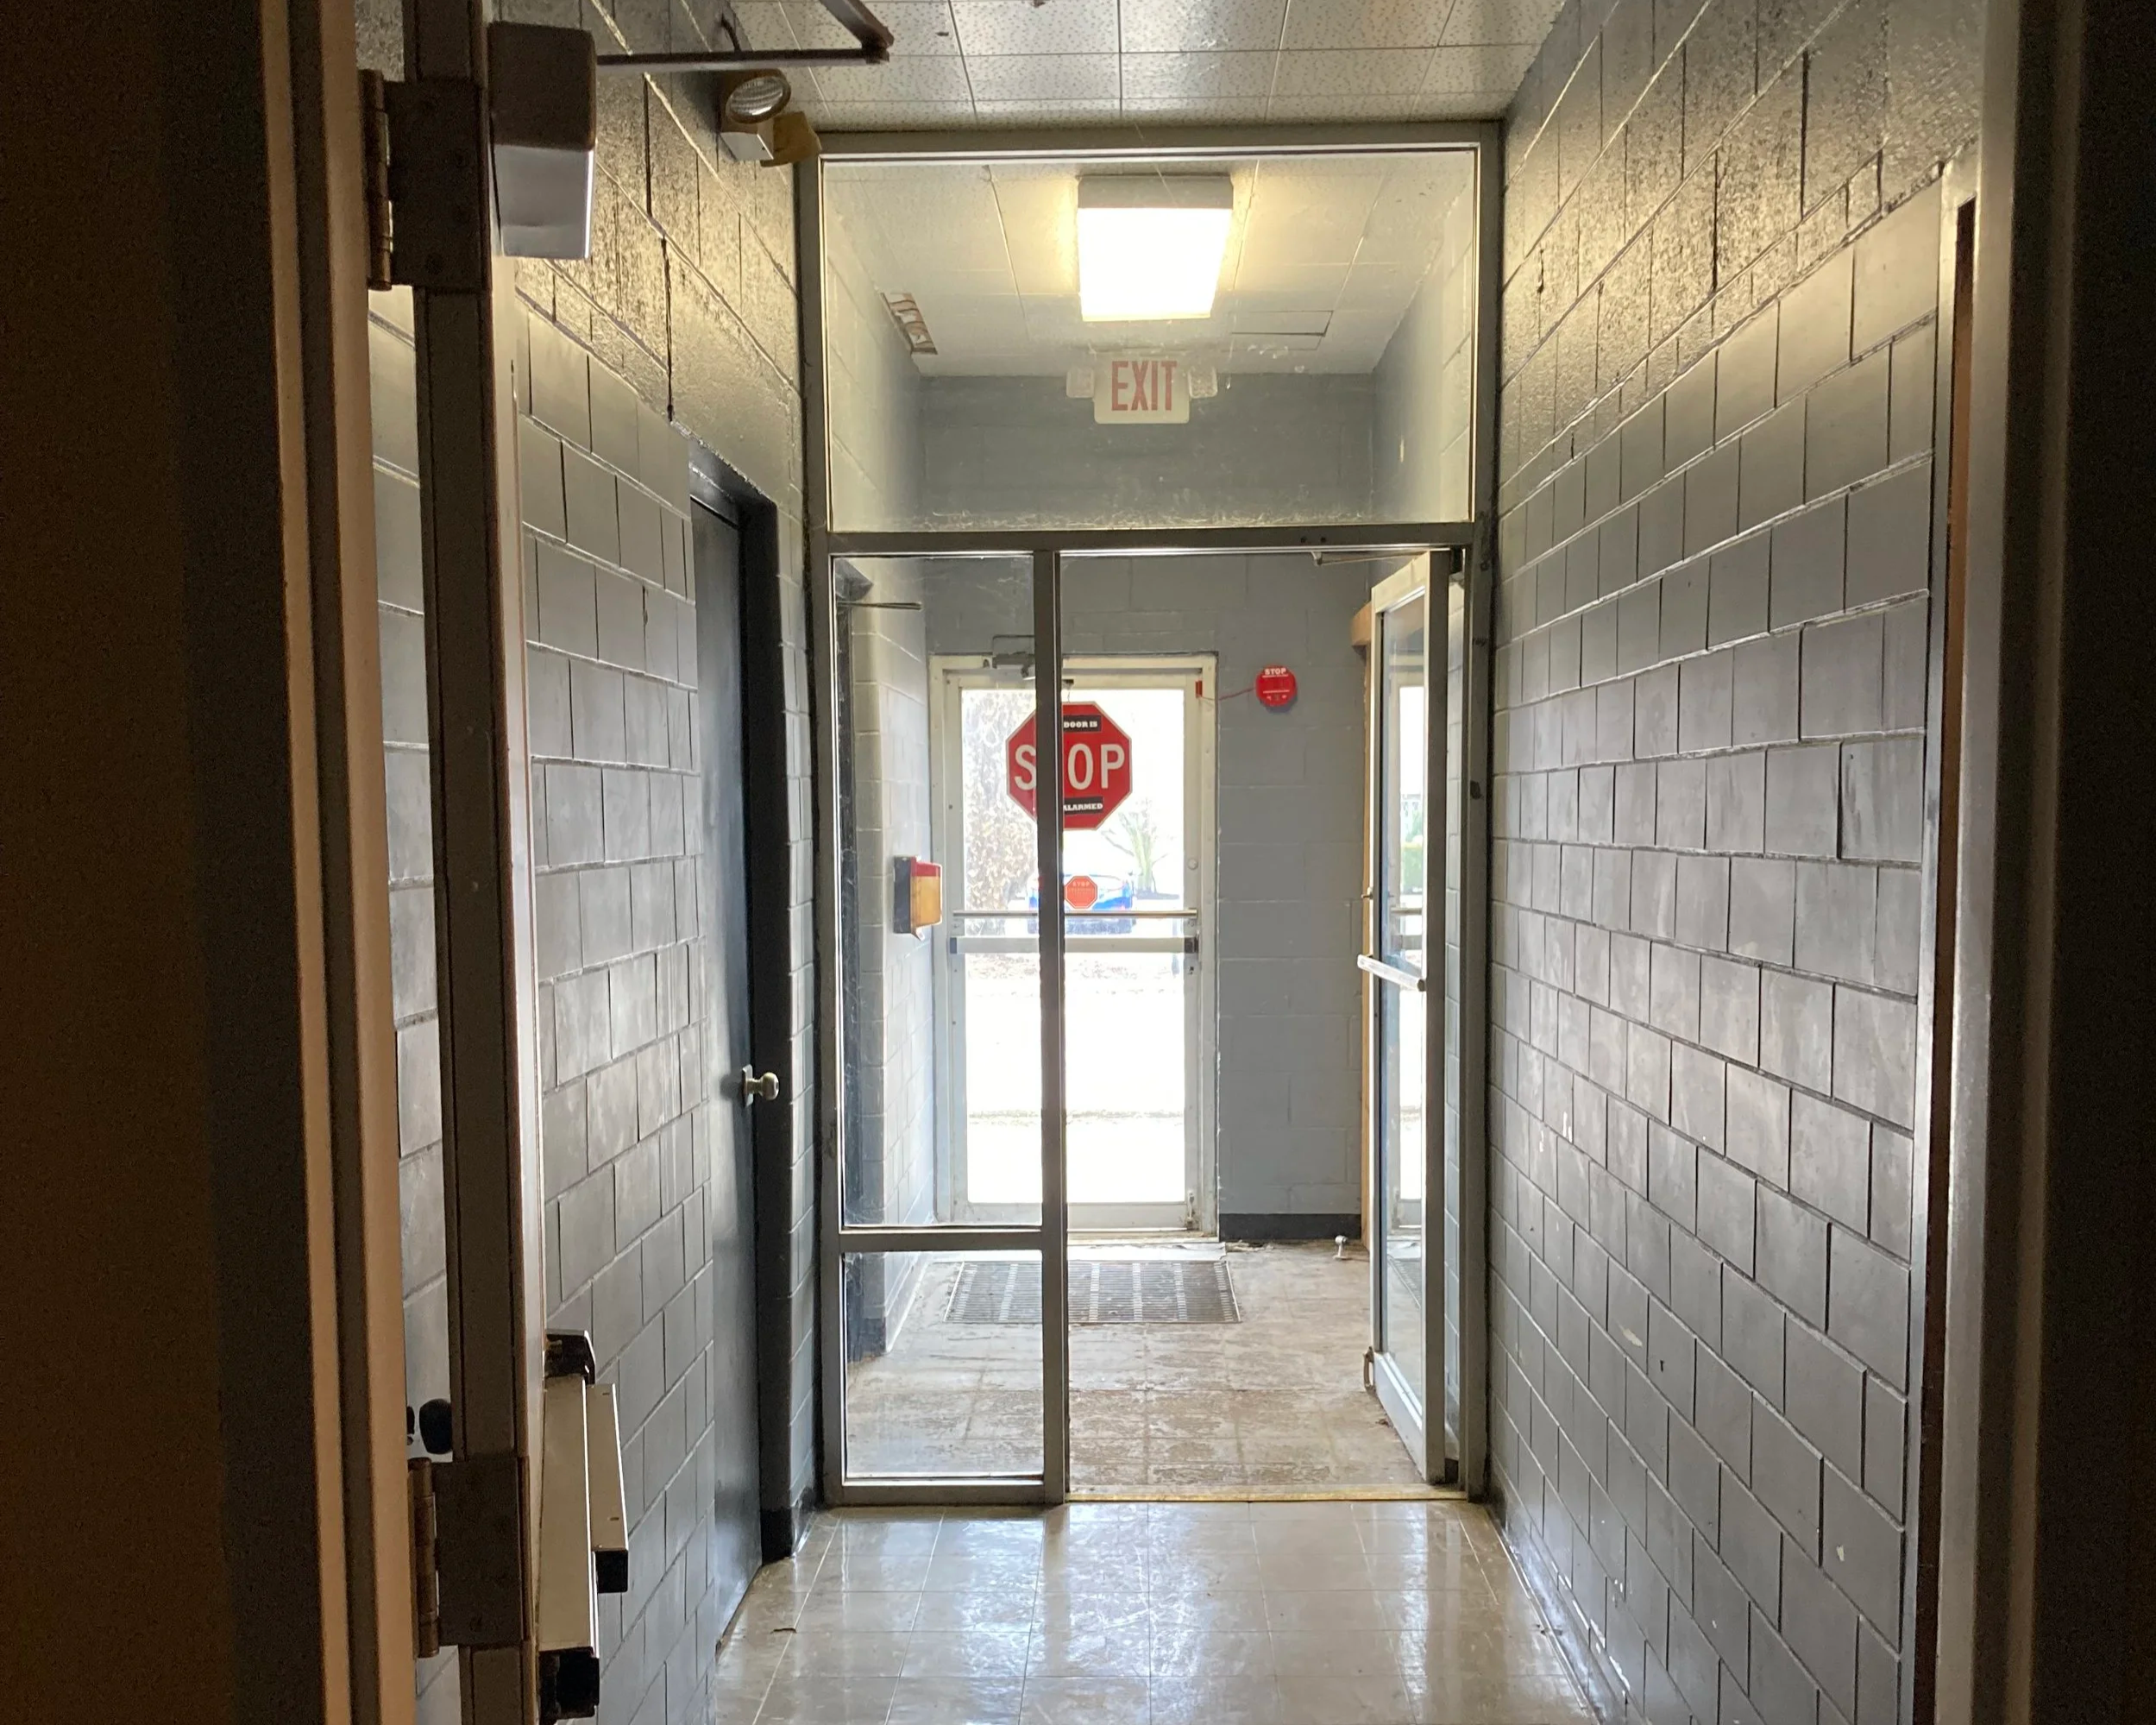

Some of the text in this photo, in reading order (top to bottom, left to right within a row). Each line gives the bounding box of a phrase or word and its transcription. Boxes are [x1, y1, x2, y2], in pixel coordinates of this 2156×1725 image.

[1111, 360, 1177, 412] EXIT
[1014, 743, 1125, 790] SOP
[1063, 803, 1103, 811] ALARMED
